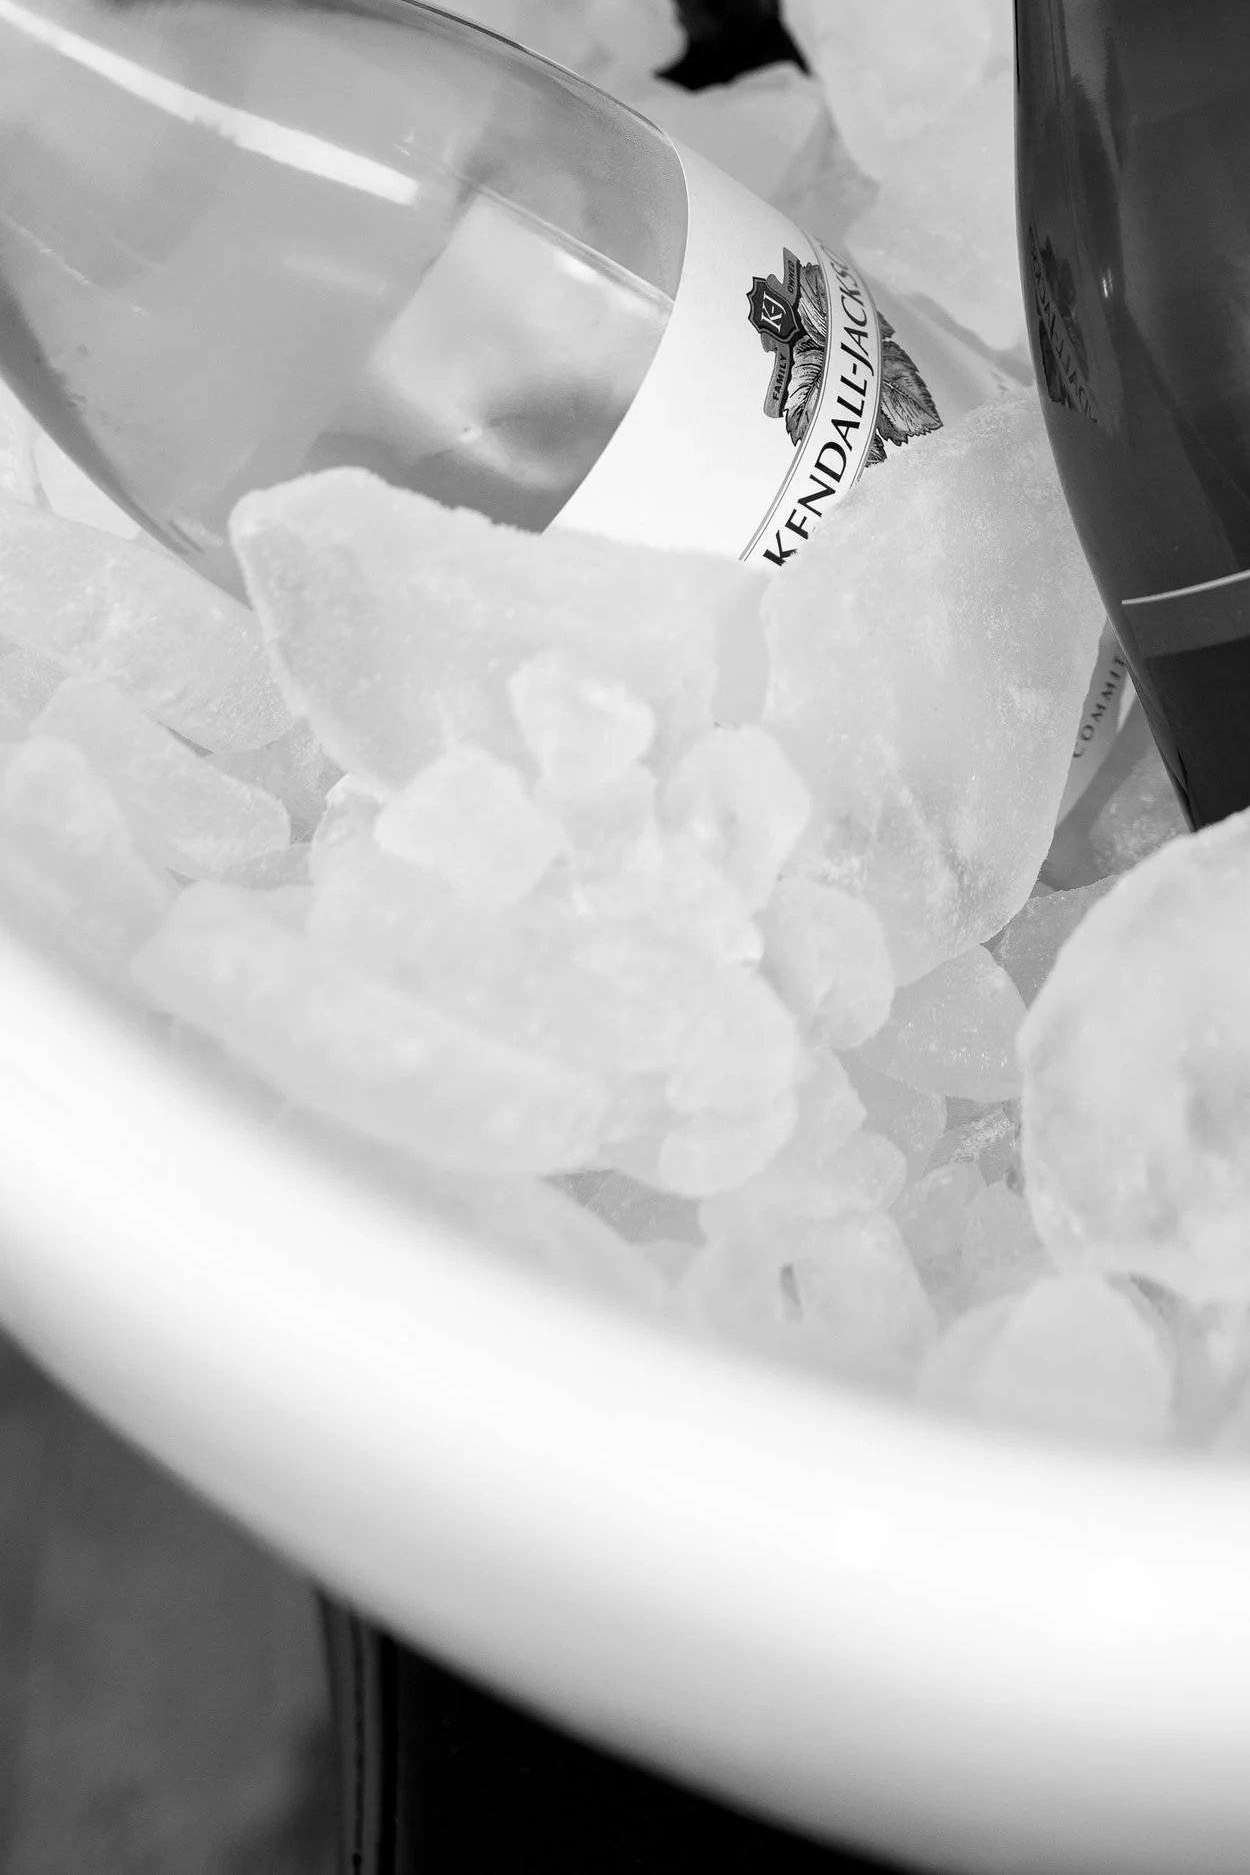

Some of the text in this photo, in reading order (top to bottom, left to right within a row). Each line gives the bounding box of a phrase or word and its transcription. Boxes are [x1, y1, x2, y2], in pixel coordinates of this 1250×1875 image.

[761, 291, 787, 333] K-J
[772, 259, 796, 401] FAMILY OWNED
[762, 236, 875, 566] KENDALL-JACKSO
